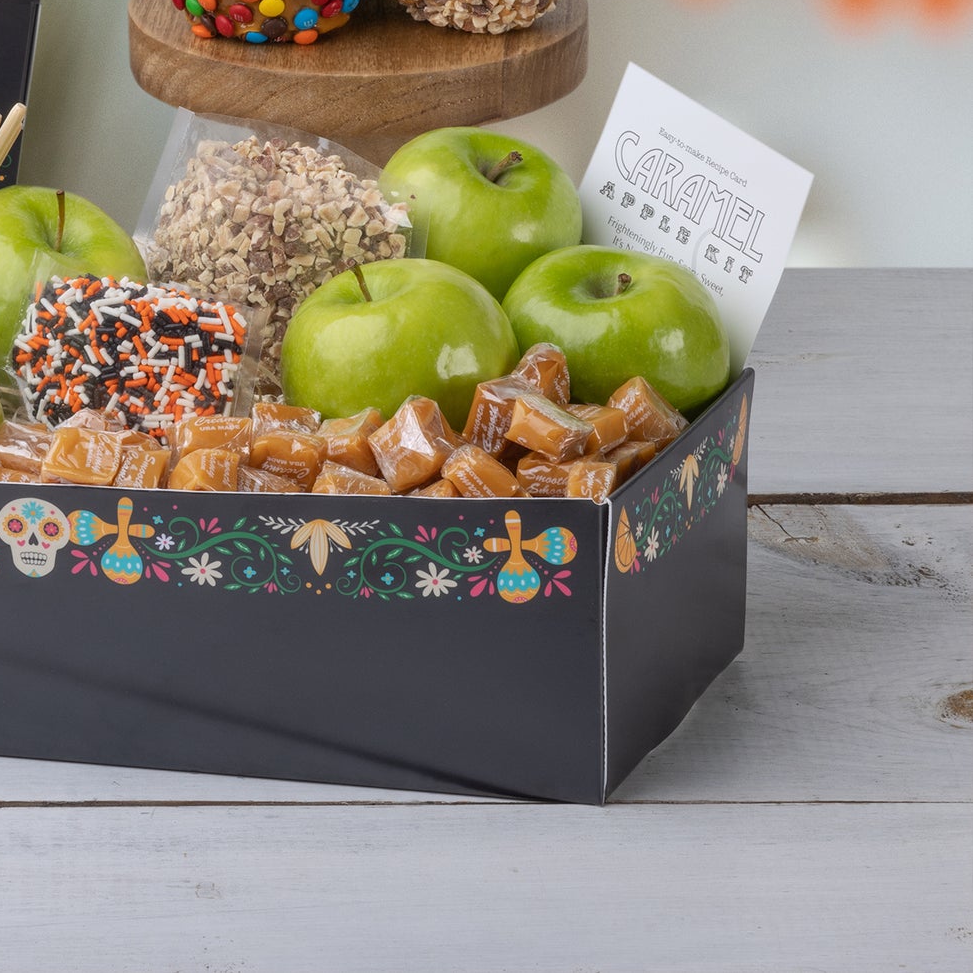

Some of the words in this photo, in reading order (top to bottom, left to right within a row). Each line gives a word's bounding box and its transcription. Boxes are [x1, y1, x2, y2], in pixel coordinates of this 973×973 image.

[614, 130, 765, 263] CARAMEL
[659, 127, 705, 161] Easy-to-make
[705, 156, 729, 177] Recipe
[729, 171, 747, 188] Card
[599, 181, 691, 245] APPLE
[704, 243, 753, 284] KIT
[607, 215, 658, 253] Frighteningly
[700, 273, 724, 297] Sweet,
